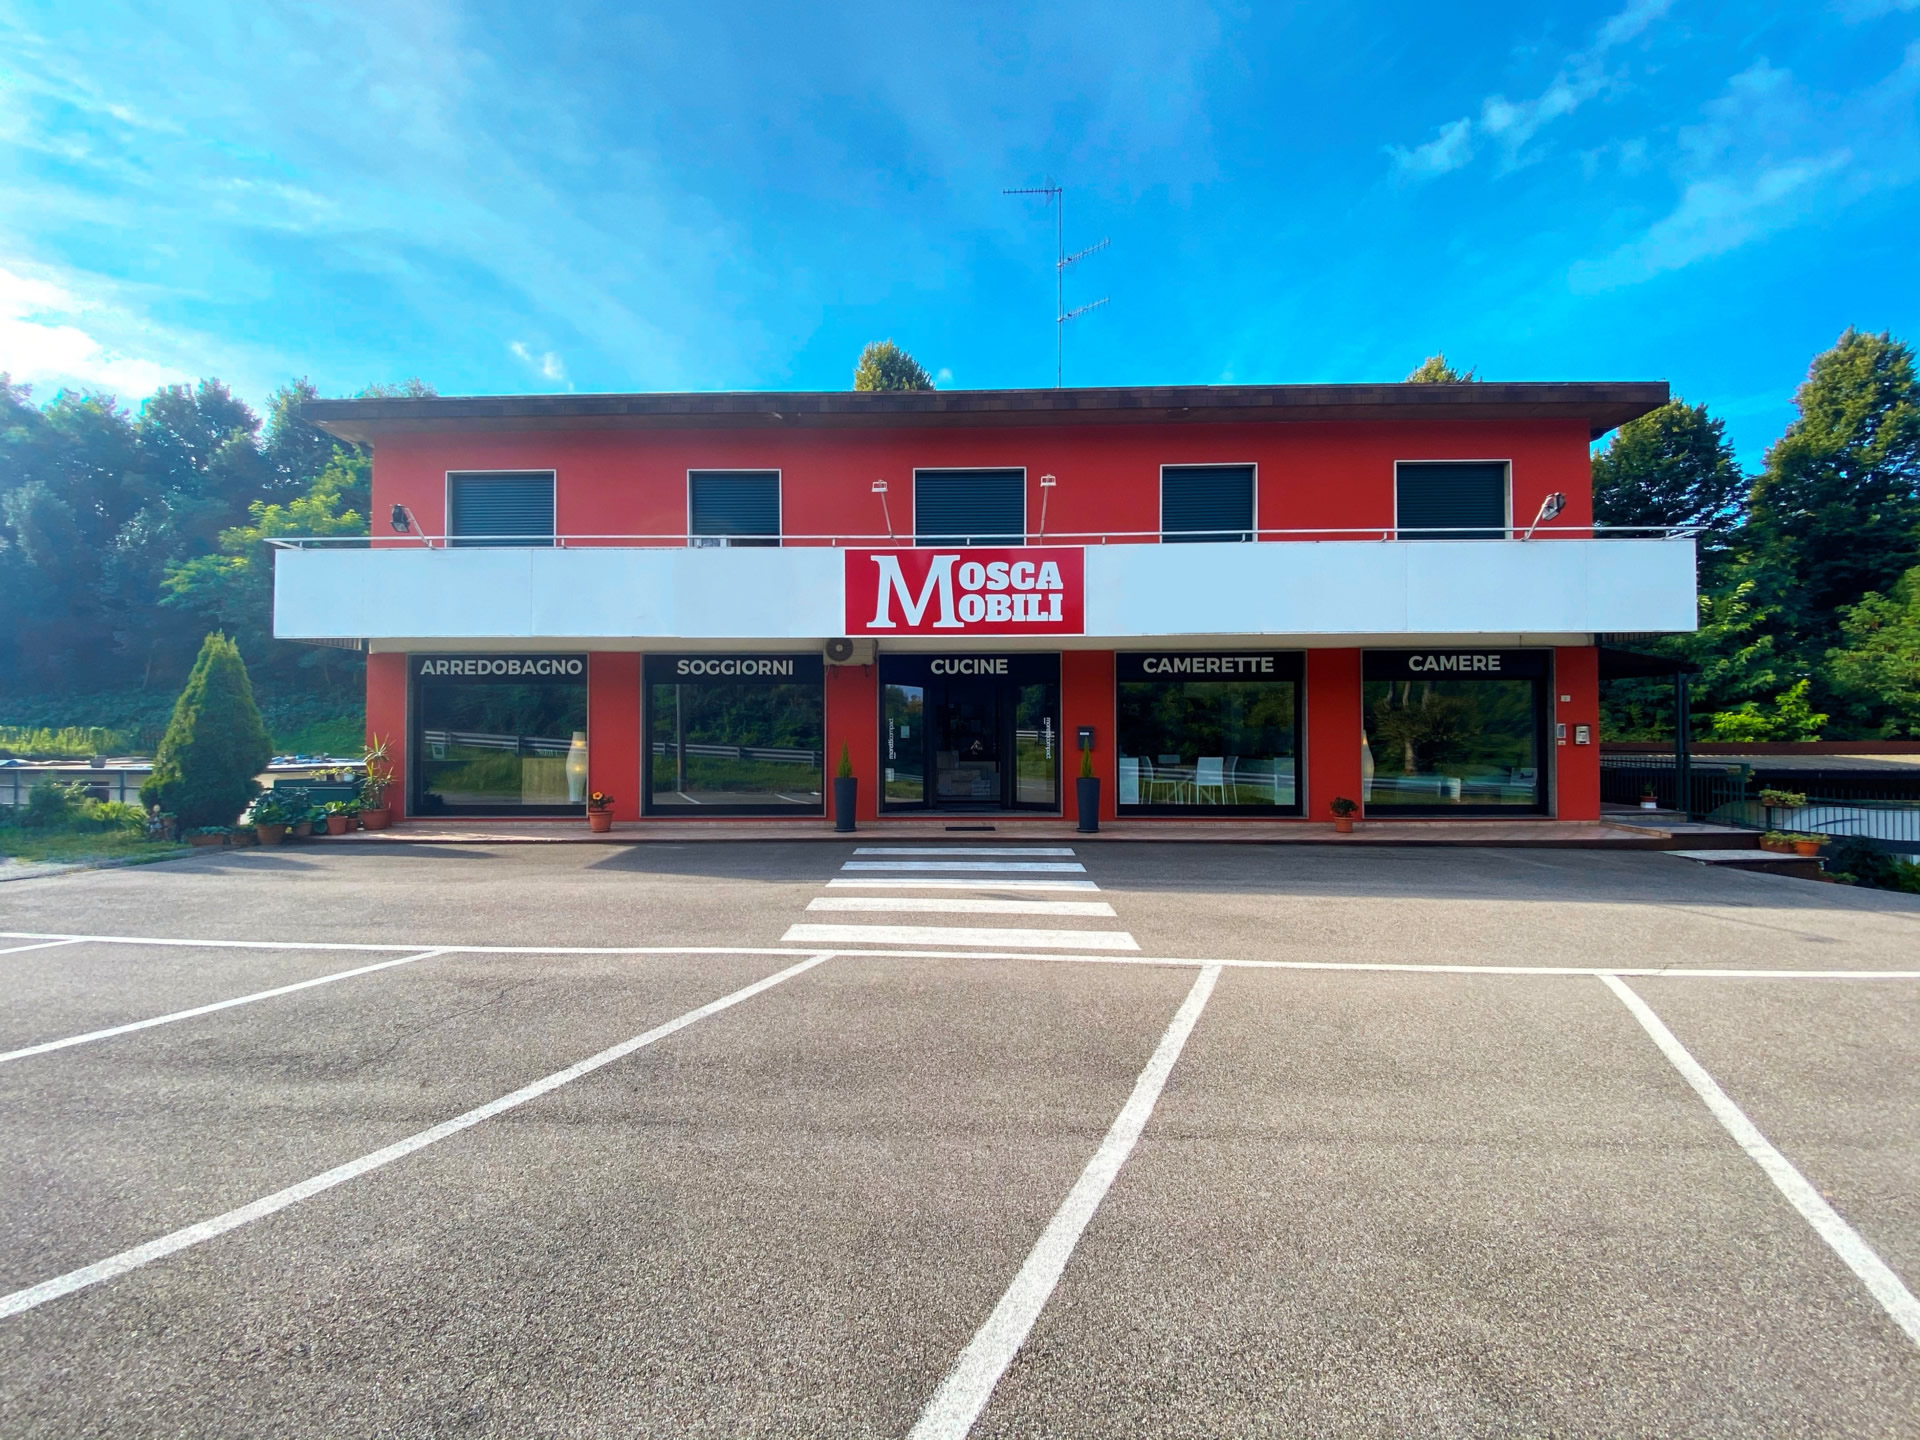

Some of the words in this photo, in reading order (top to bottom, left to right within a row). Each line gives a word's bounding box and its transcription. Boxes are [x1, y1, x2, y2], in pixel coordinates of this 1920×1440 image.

[420, 659, 583, 676] ARREDOBAGNO
[677, 659, 794, 676] SOGGIORNI
[930, 658, 1009, 675] CUCINE
[1142, 657, 1275, 673] CAMERETTE
[1408, 655, 1501, 671] CAMERE
